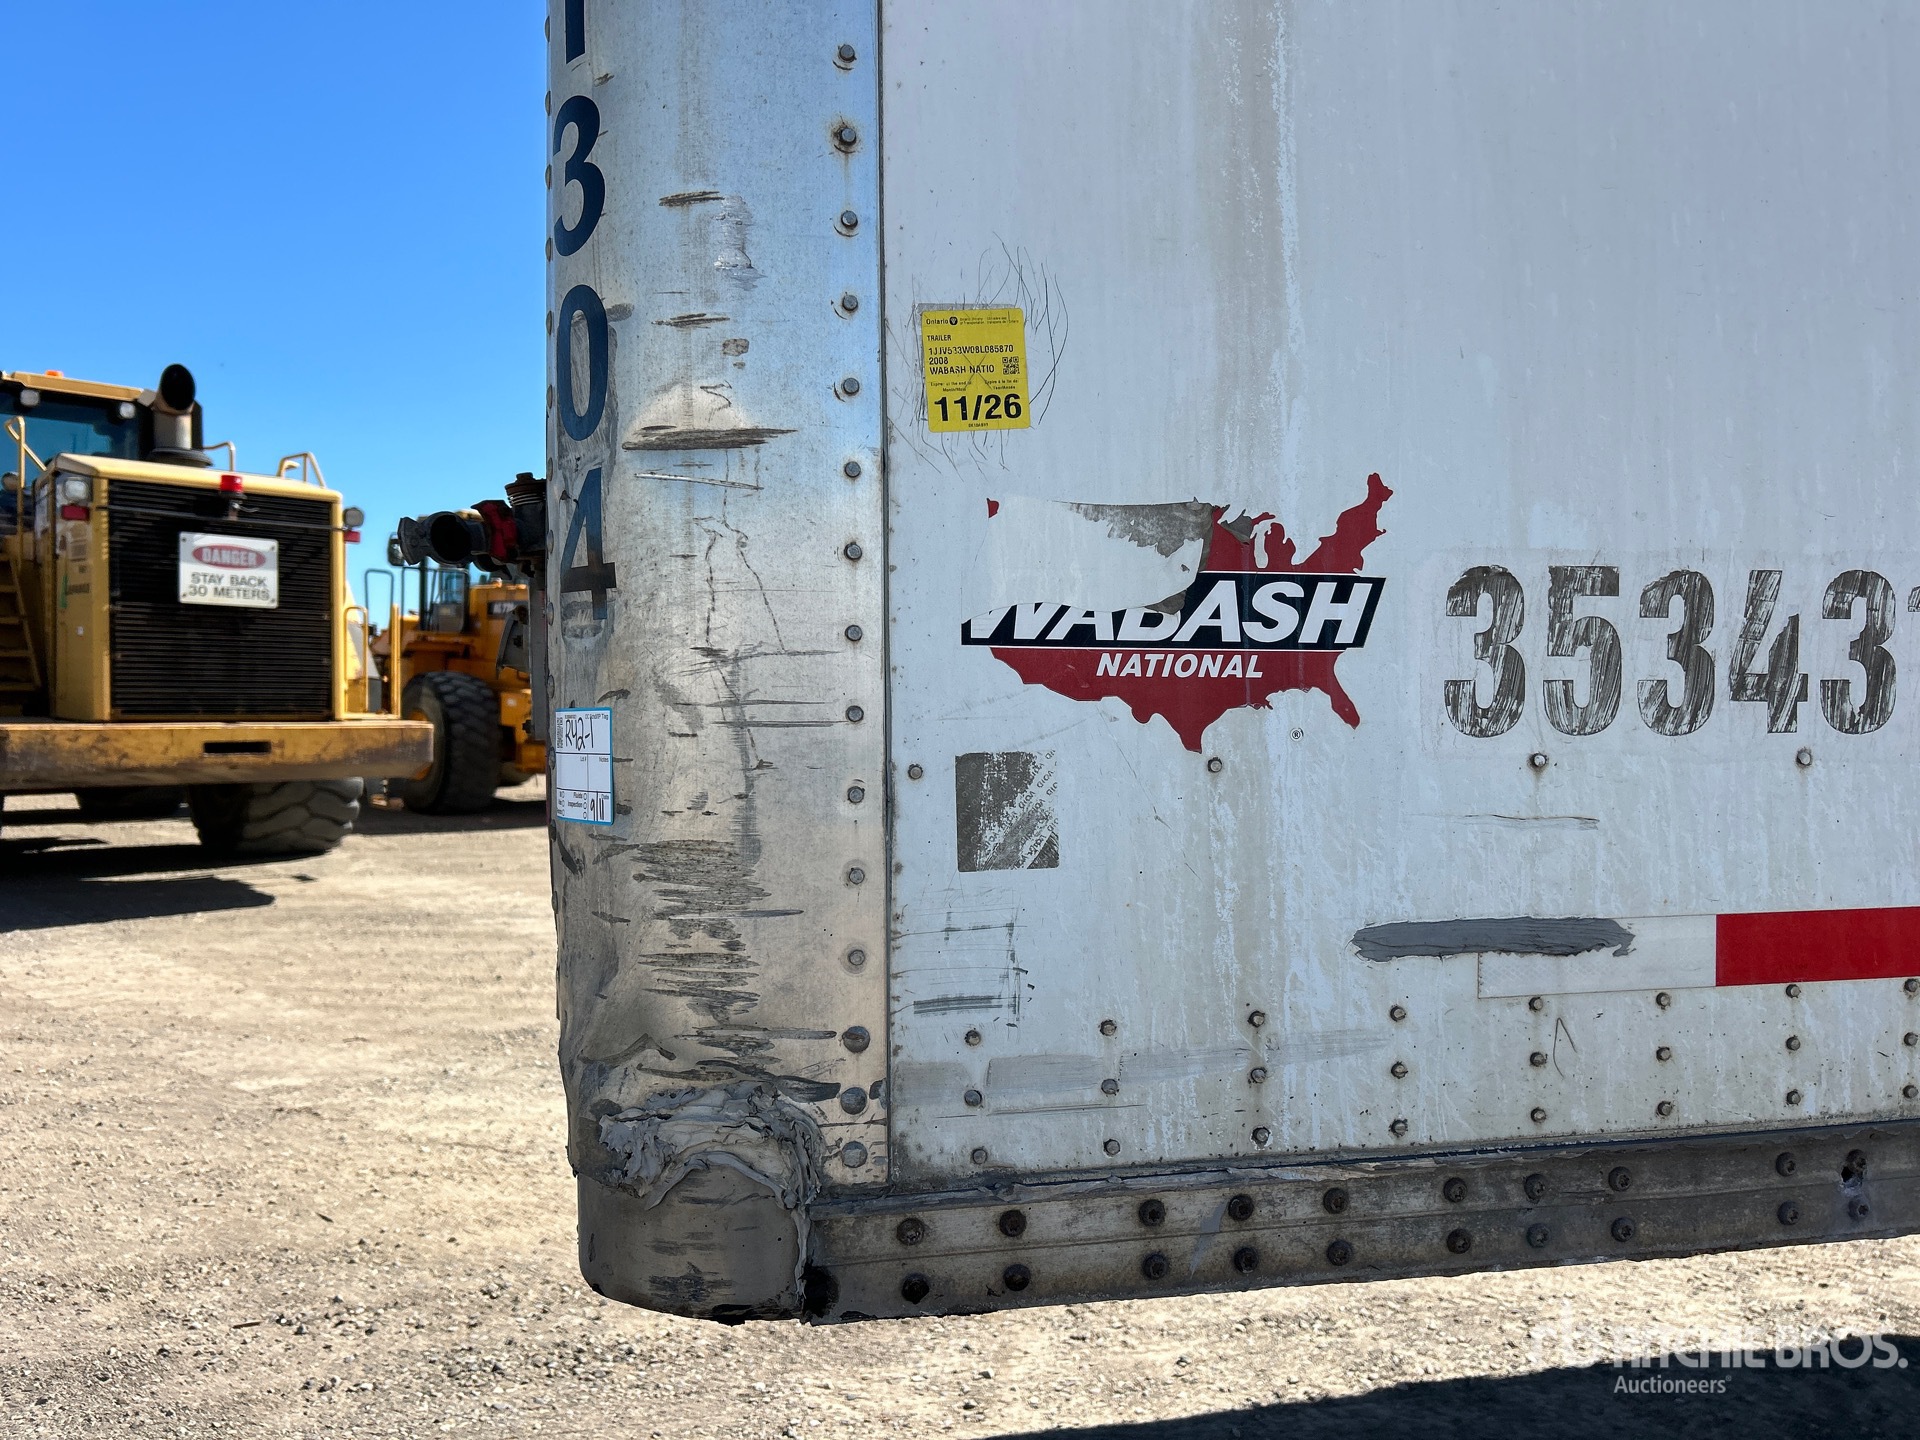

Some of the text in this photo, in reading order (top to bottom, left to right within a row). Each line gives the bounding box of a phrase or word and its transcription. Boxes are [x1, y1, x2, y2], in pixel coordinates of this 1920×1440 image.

[929, 357, 949, 365] 2008
[930, 365, 995, 375] WABASH NATIO
[934, 393, 1022, 421] 11/26
[202, 548, 257, 566] DANGER
[191, 572, 267, 588] STAY BACK
[189, 584, 270, 601] 30 METERS
[1443, 565, 1920, 738] 35343
[1096, 653, 1263, 679] NATIONAL
